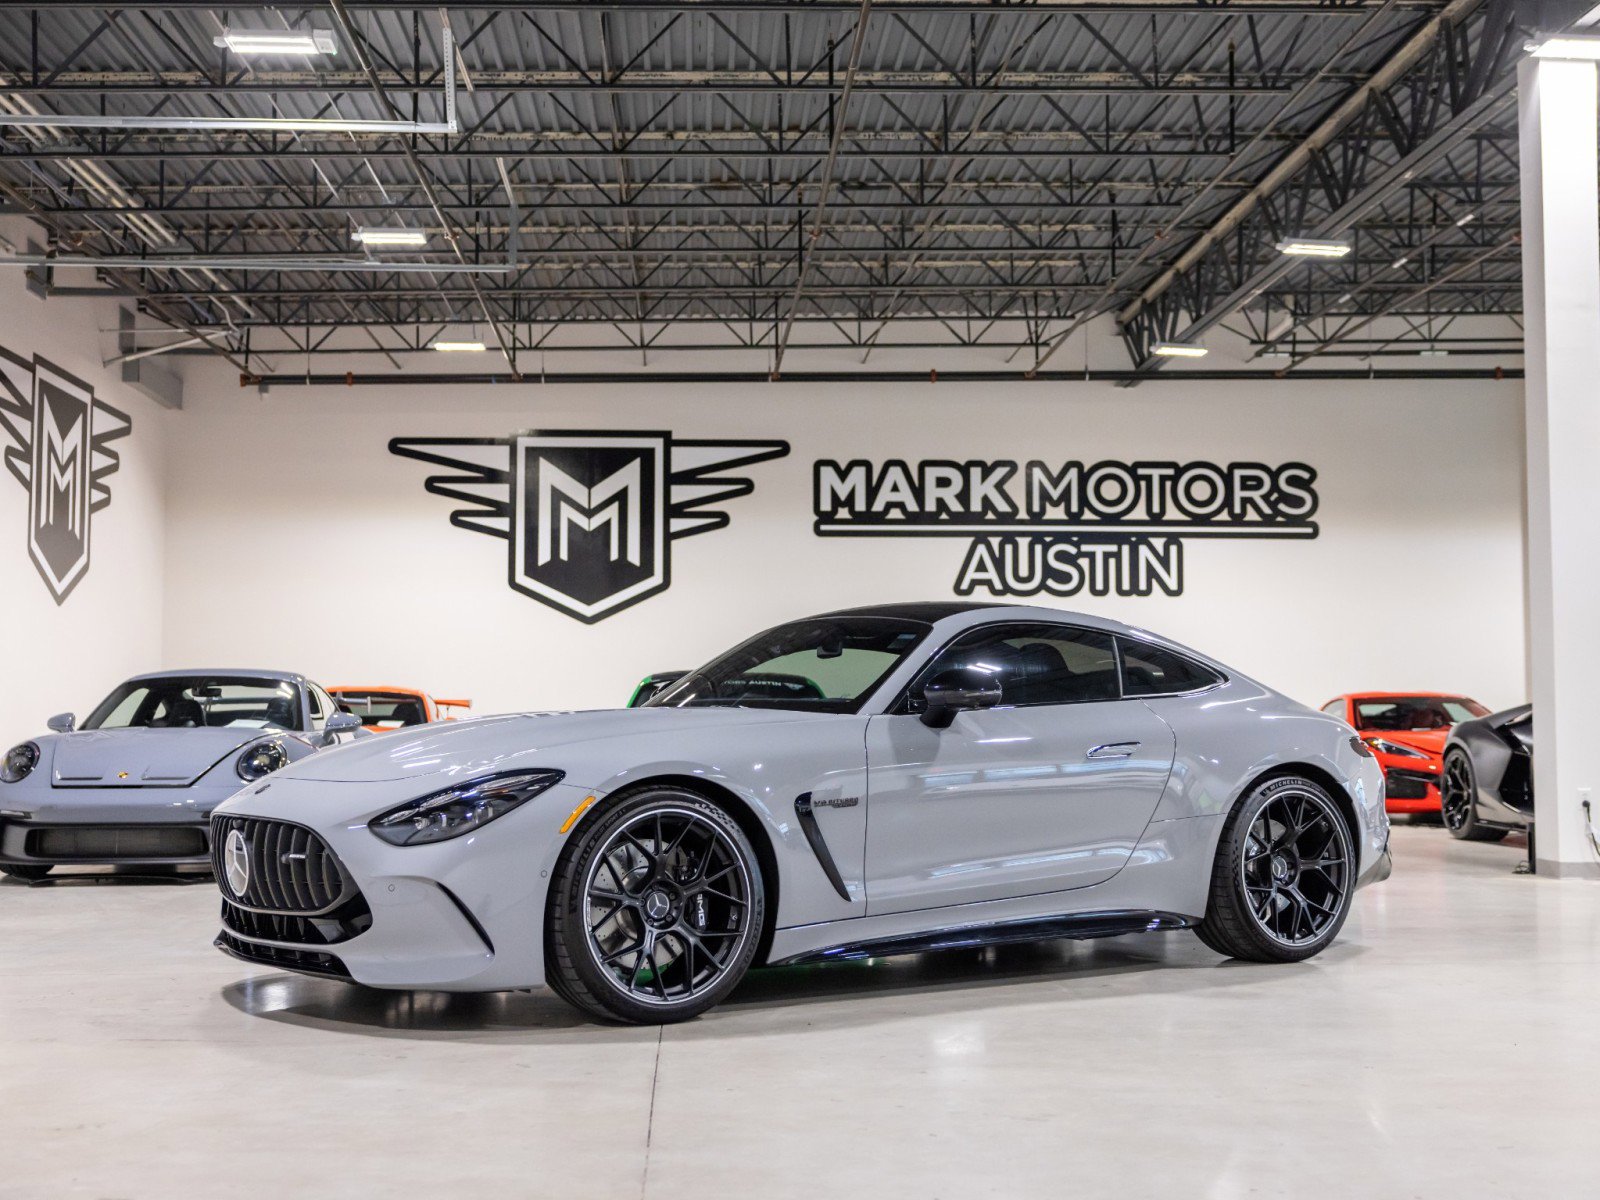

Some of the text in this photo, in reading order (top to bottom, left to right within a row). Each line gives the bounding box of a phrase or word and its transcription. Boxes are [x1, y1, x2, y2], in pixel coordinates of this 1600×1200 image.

[817, 462, 1317, 518] MARK MOTORS
[957, 539, 1181, 594] AUSTIN
[1269, 779, 1302, 791] MICHELIN
